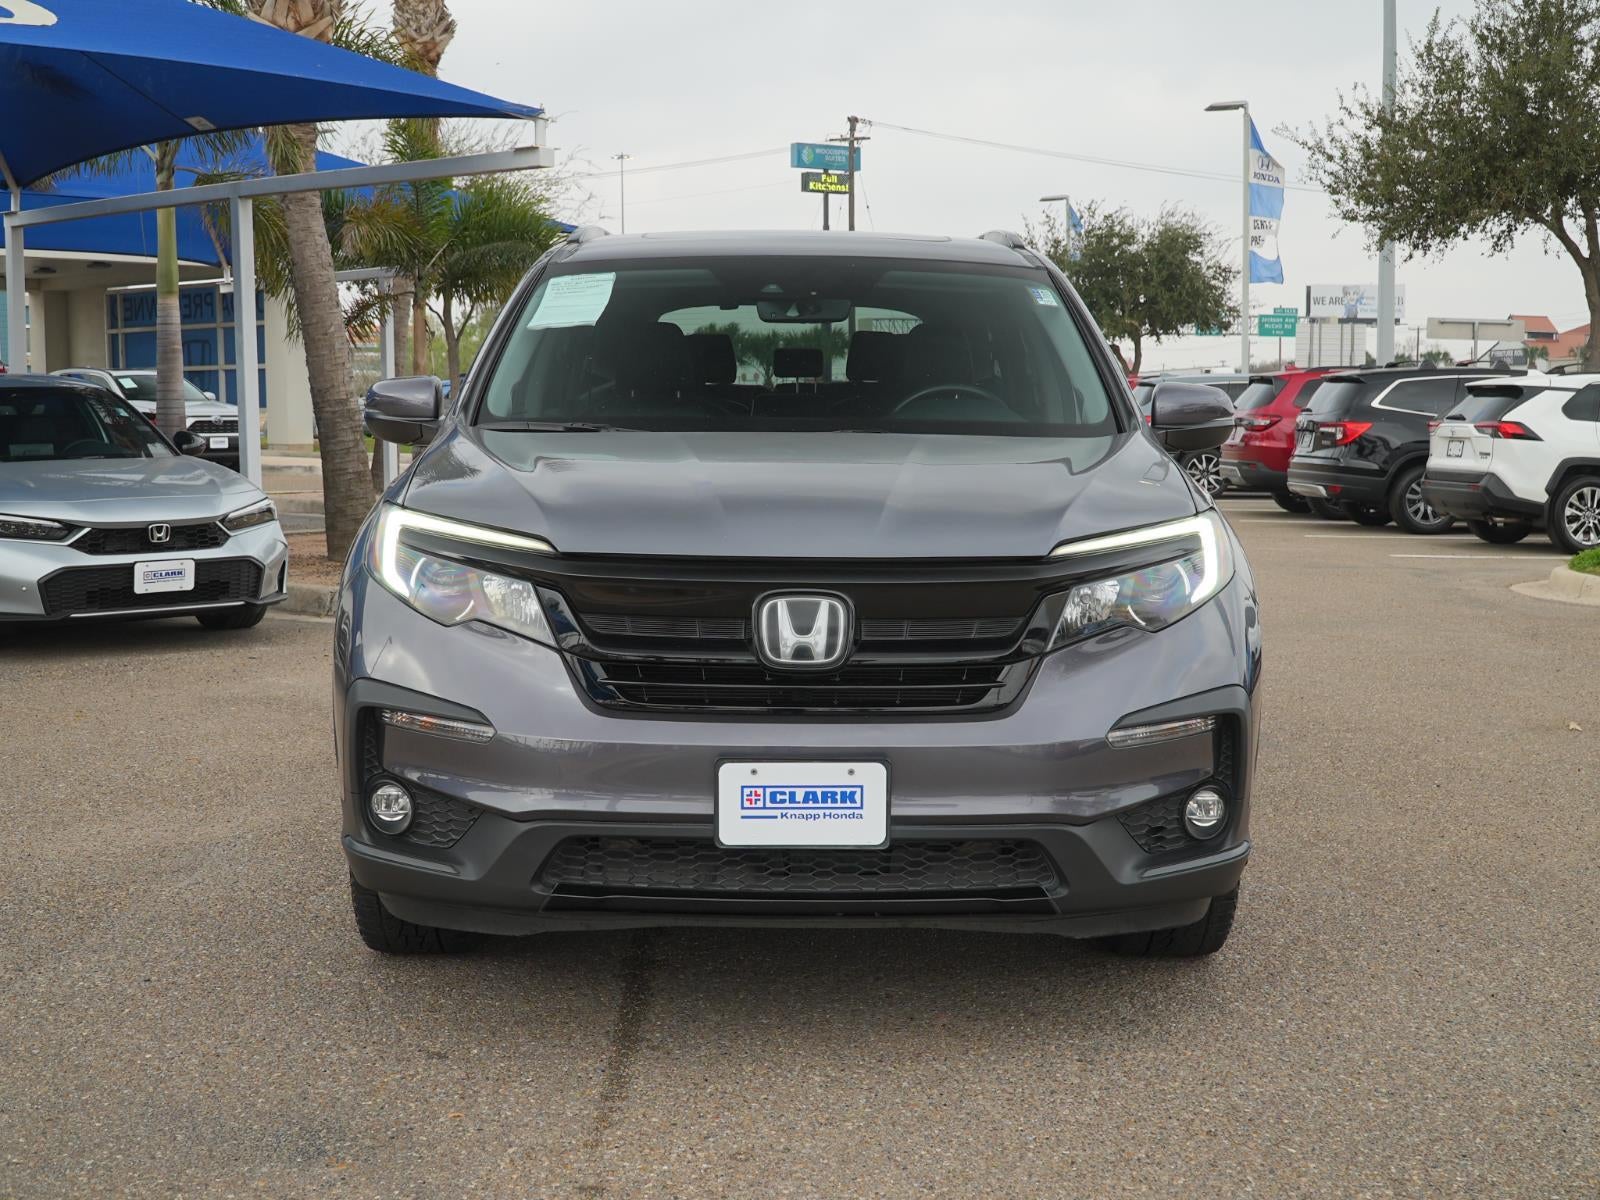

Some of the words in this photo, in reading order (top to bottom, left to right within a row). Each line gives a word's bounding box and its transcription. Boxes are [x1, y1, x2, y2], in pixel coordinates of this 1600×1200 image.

[821, 174, 838, 182] Full
[1312, 296, 1327, 306] WE
[1328, 296, 1345, 306] ARE
[769, 790, 858, 805] CLARK
[780, 811, 820, 821] Knapp
[823, 811, 864, 820] Honda
